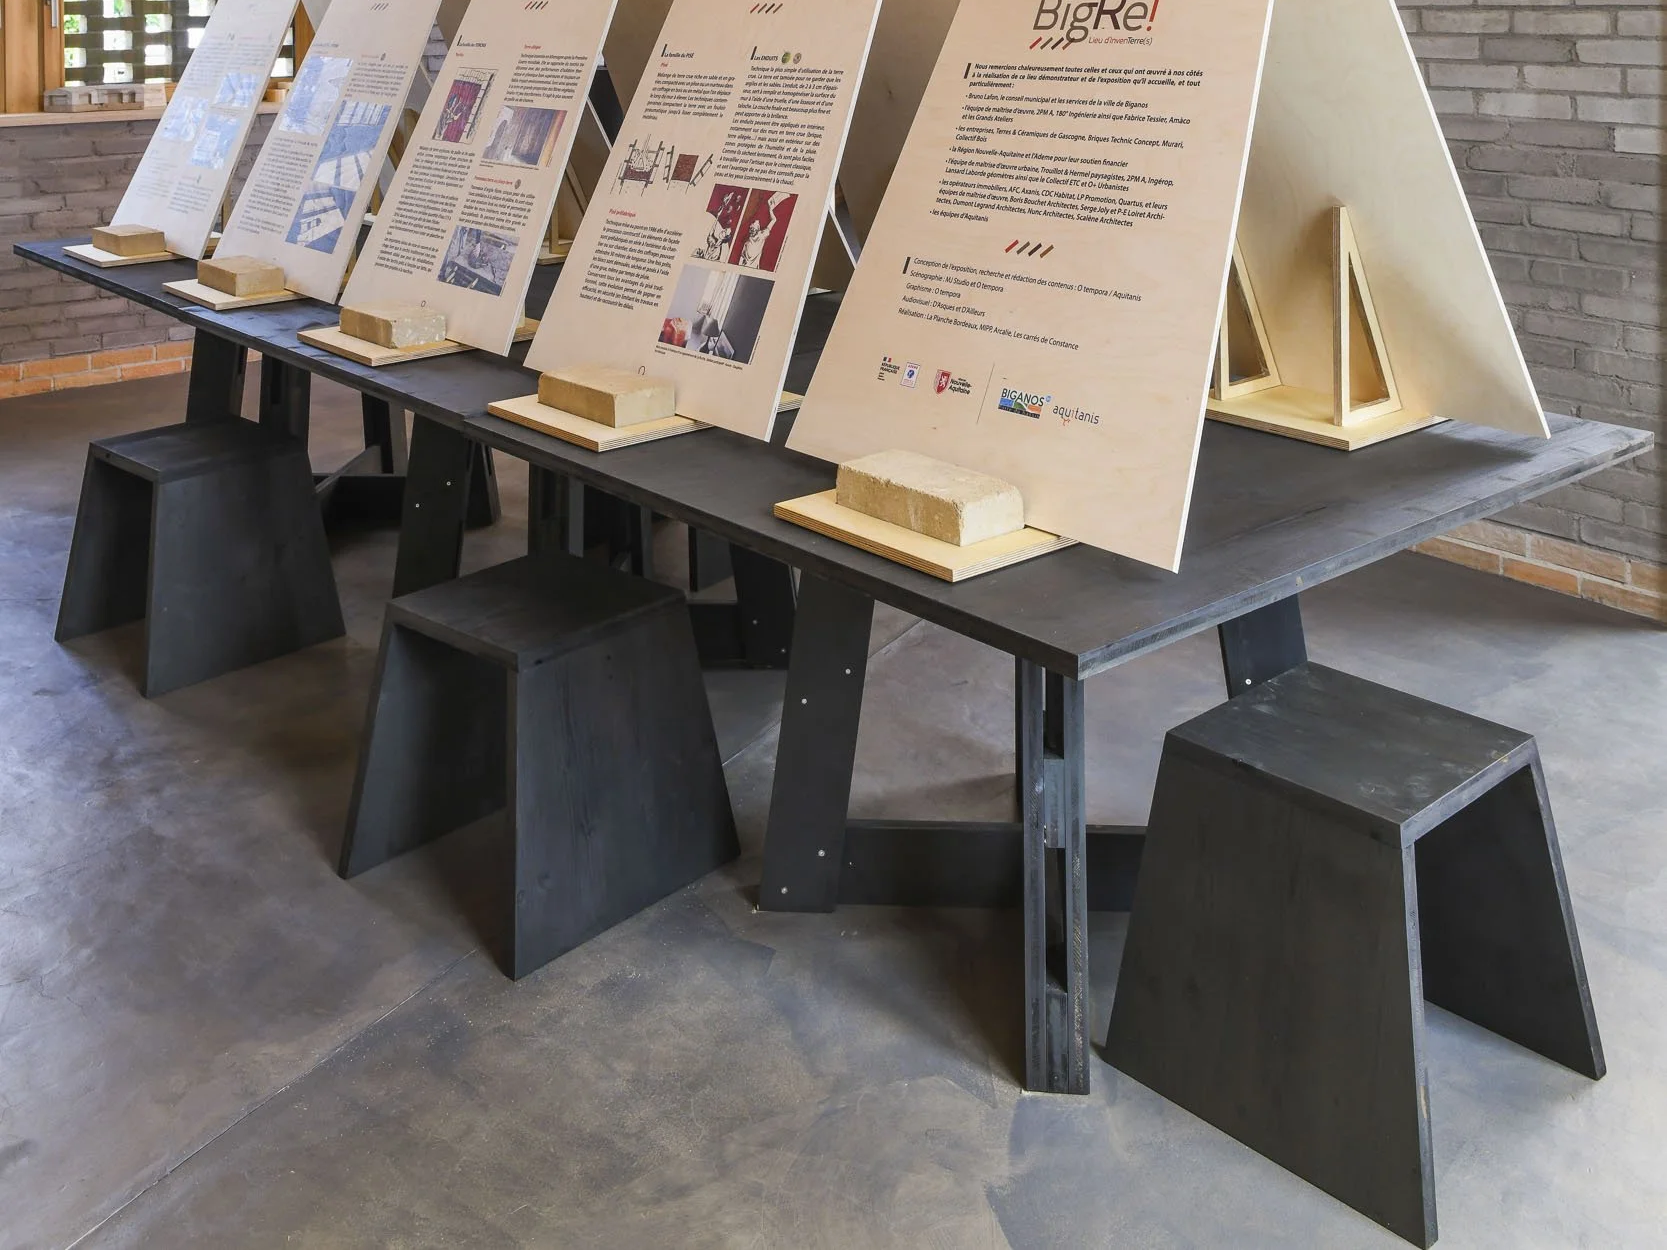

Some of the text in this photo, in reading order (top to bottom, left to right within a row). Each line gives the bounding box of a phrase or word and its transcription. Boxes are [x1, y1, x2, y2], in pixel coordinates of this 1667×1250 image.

[1097, 76, 1131, 84] l'exposition
[1124, 100, 1148, 109] Biganos
[1068, 111, 1097, 119] Ingénierie
[1124, 114, 1146, 122] Fabrice
[1017, 129, 1049, 138] Céramiques
[1088, 134, 1109, 143] Briques
[1111, 136, 1133, 144] Technic
[957, 146, 974, 154] Région
[975, 148, 1024, 158] Nouvelle-Aquitaine
[1031, 153, 1053, 161] l'Ademe
[1102, 158, 1128, 167] financier
[948, 158, 968, 166] l'équipe
[1041, 166, 1064, 175] Trouillot
[965, 169, 986, 177] Laborde
[986, 172, 1014, 180] géomètres
[1046, 177, 1070, 185] Collectif
[1098, 182, 1129, 192] Urbanistes
[940, 210, 960, 218] équipes
[960, 212, 988, 222] d'Aquitanis
[948, 385, 970, 394] Aquitaine
[1001, 388, 1044, 407] BIGANOS
[1052, 405, 1100, 424] aquitanis
